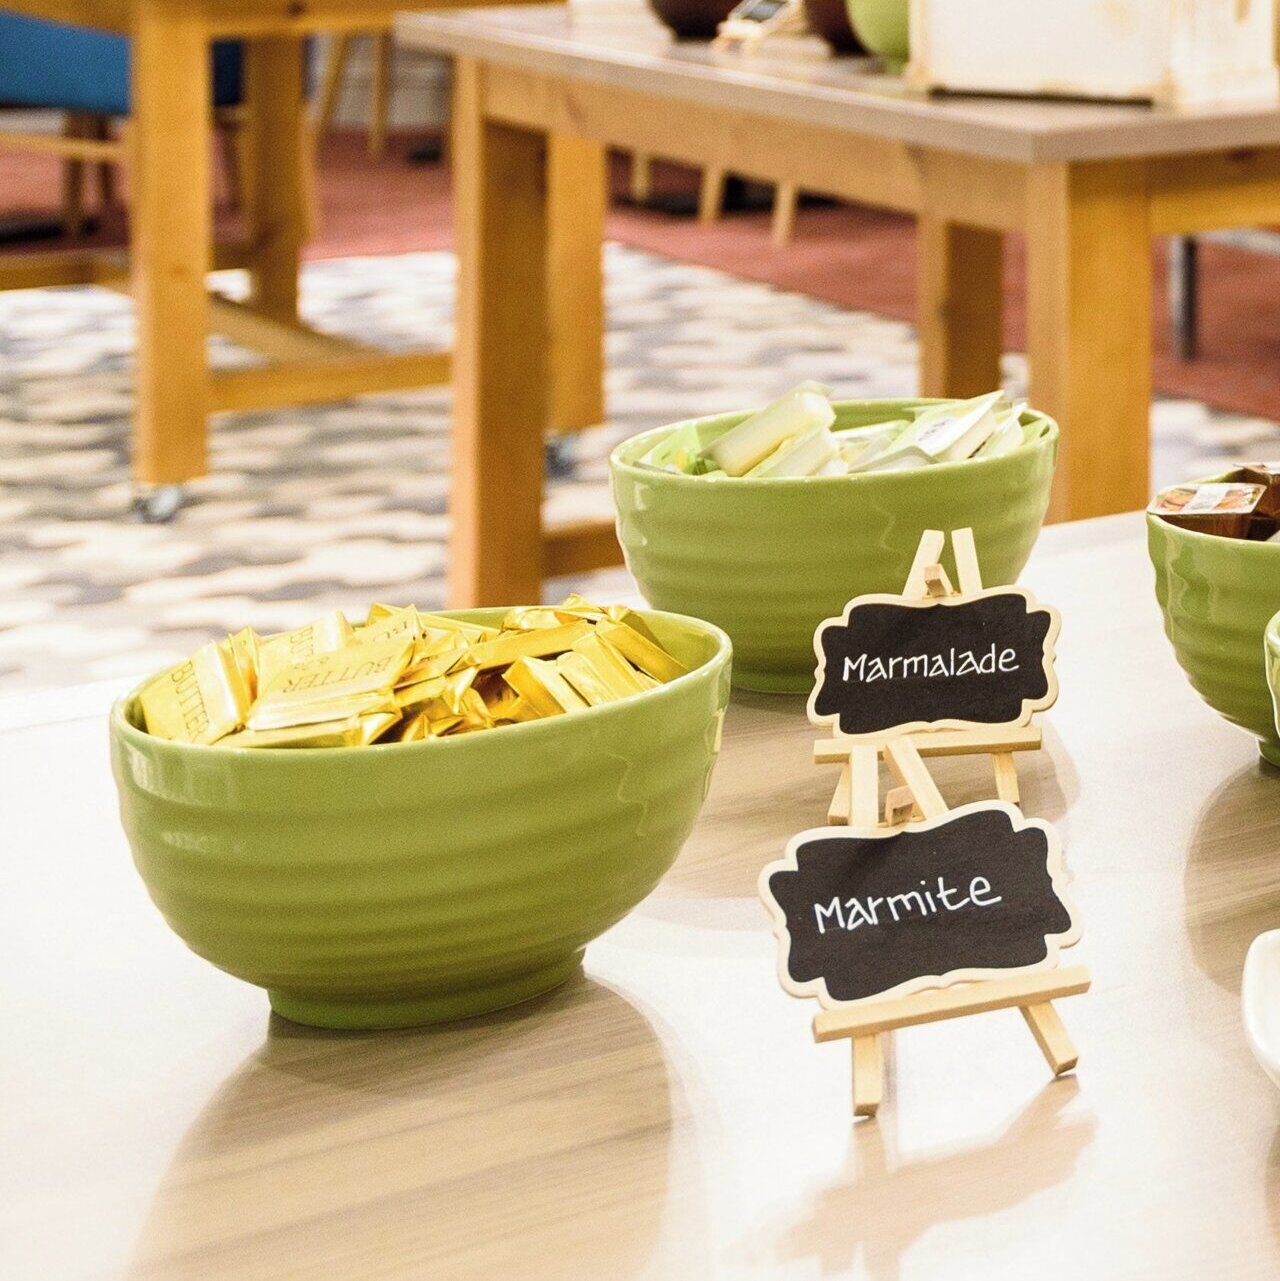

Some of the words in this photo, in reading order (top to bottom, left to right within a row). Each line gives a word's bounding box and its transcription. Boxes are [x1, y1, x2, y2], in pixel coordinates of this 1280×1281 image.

[282, 655, 394, 694] BUTTER
[842, 643, 1020, 683] Marmalade
[170, 659, 211, 744] BUTTER
[813, 875, 1003, 934] Marmite
